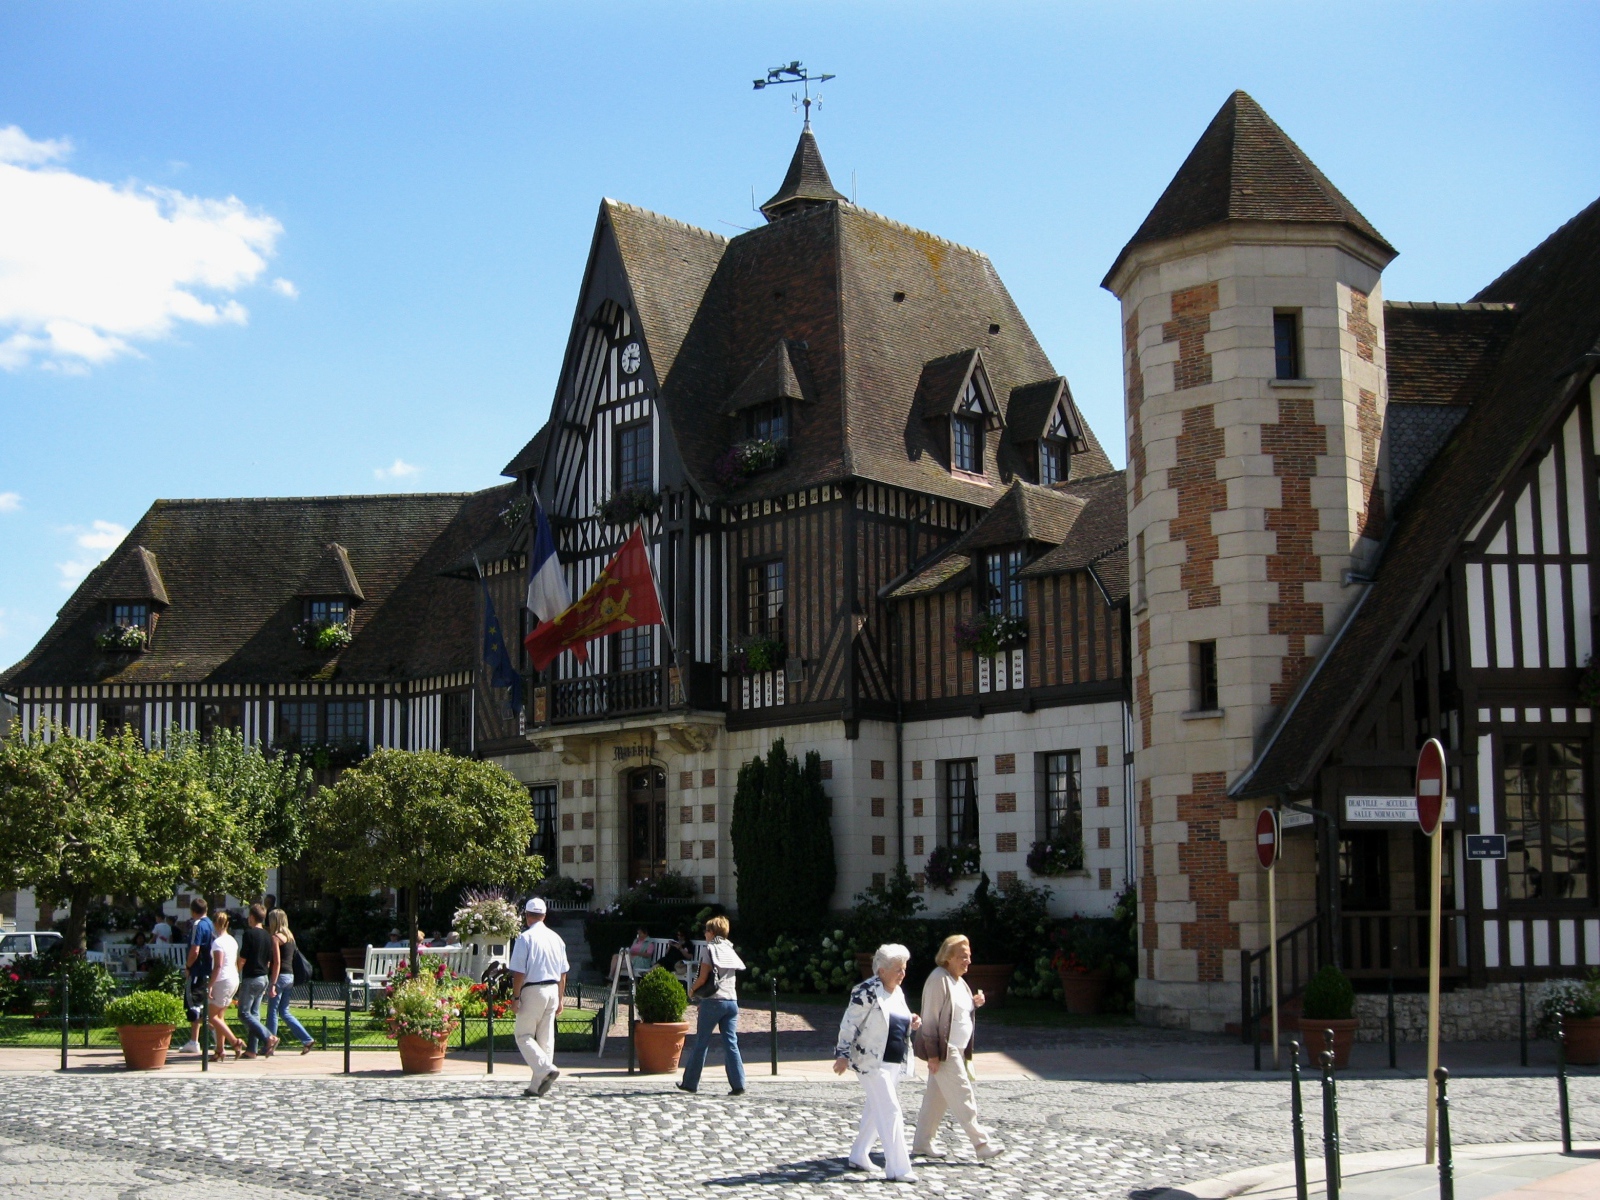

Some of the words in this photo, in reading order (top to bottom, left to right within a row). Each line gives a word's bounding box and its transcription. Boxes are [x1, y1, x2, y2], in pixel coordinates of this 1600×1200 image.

[1348, 799, 1378, 808] DEAUVILLE
[1386, 799, 1409, 808] ACCUEIL
[1354, 810, 1372, 818] SALLE
[1374, 810, 1407, 819] NORMANDE
